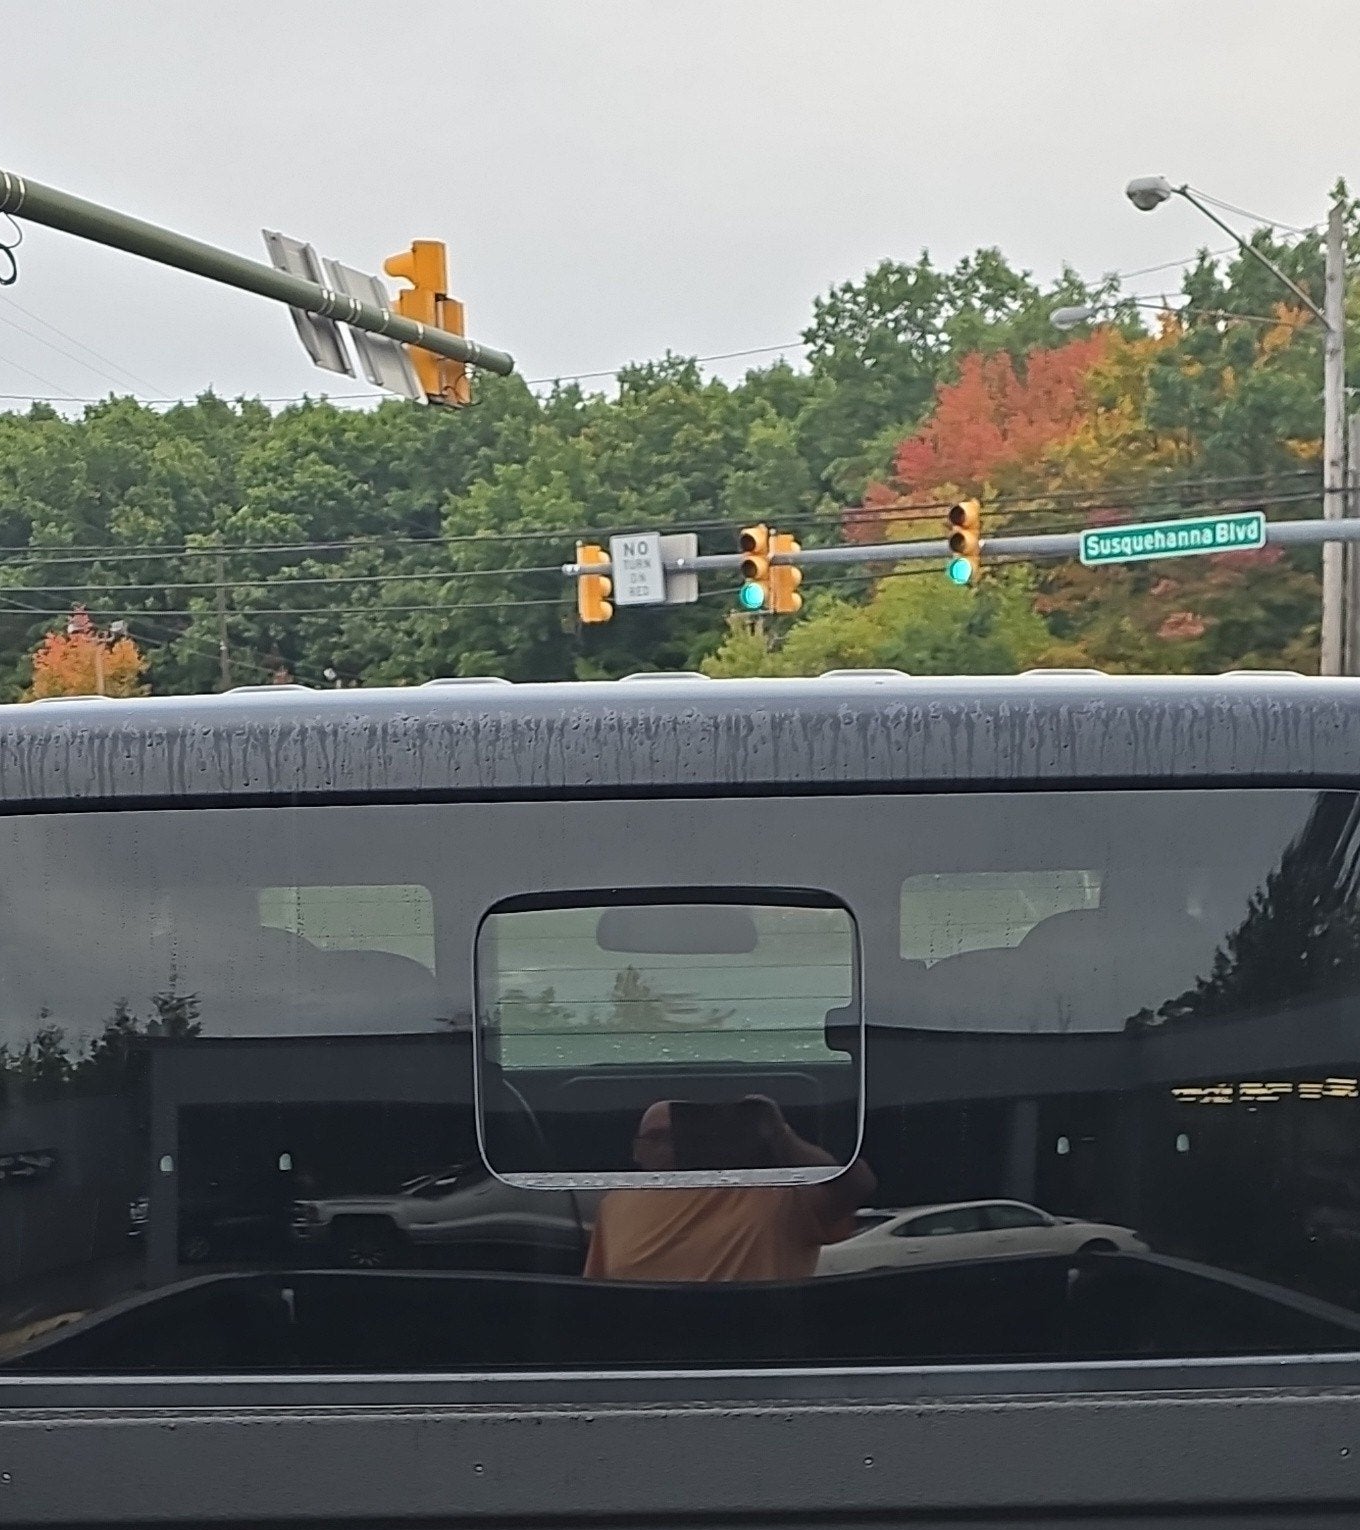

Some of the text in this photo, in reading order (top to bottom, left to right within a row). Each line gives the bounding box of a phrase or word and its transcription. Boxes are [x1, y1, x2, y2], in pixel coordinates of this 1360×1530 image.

[623, 541, 648, 556] NO
[1086, 519, 1259, 556] Susquehanna Blvd
